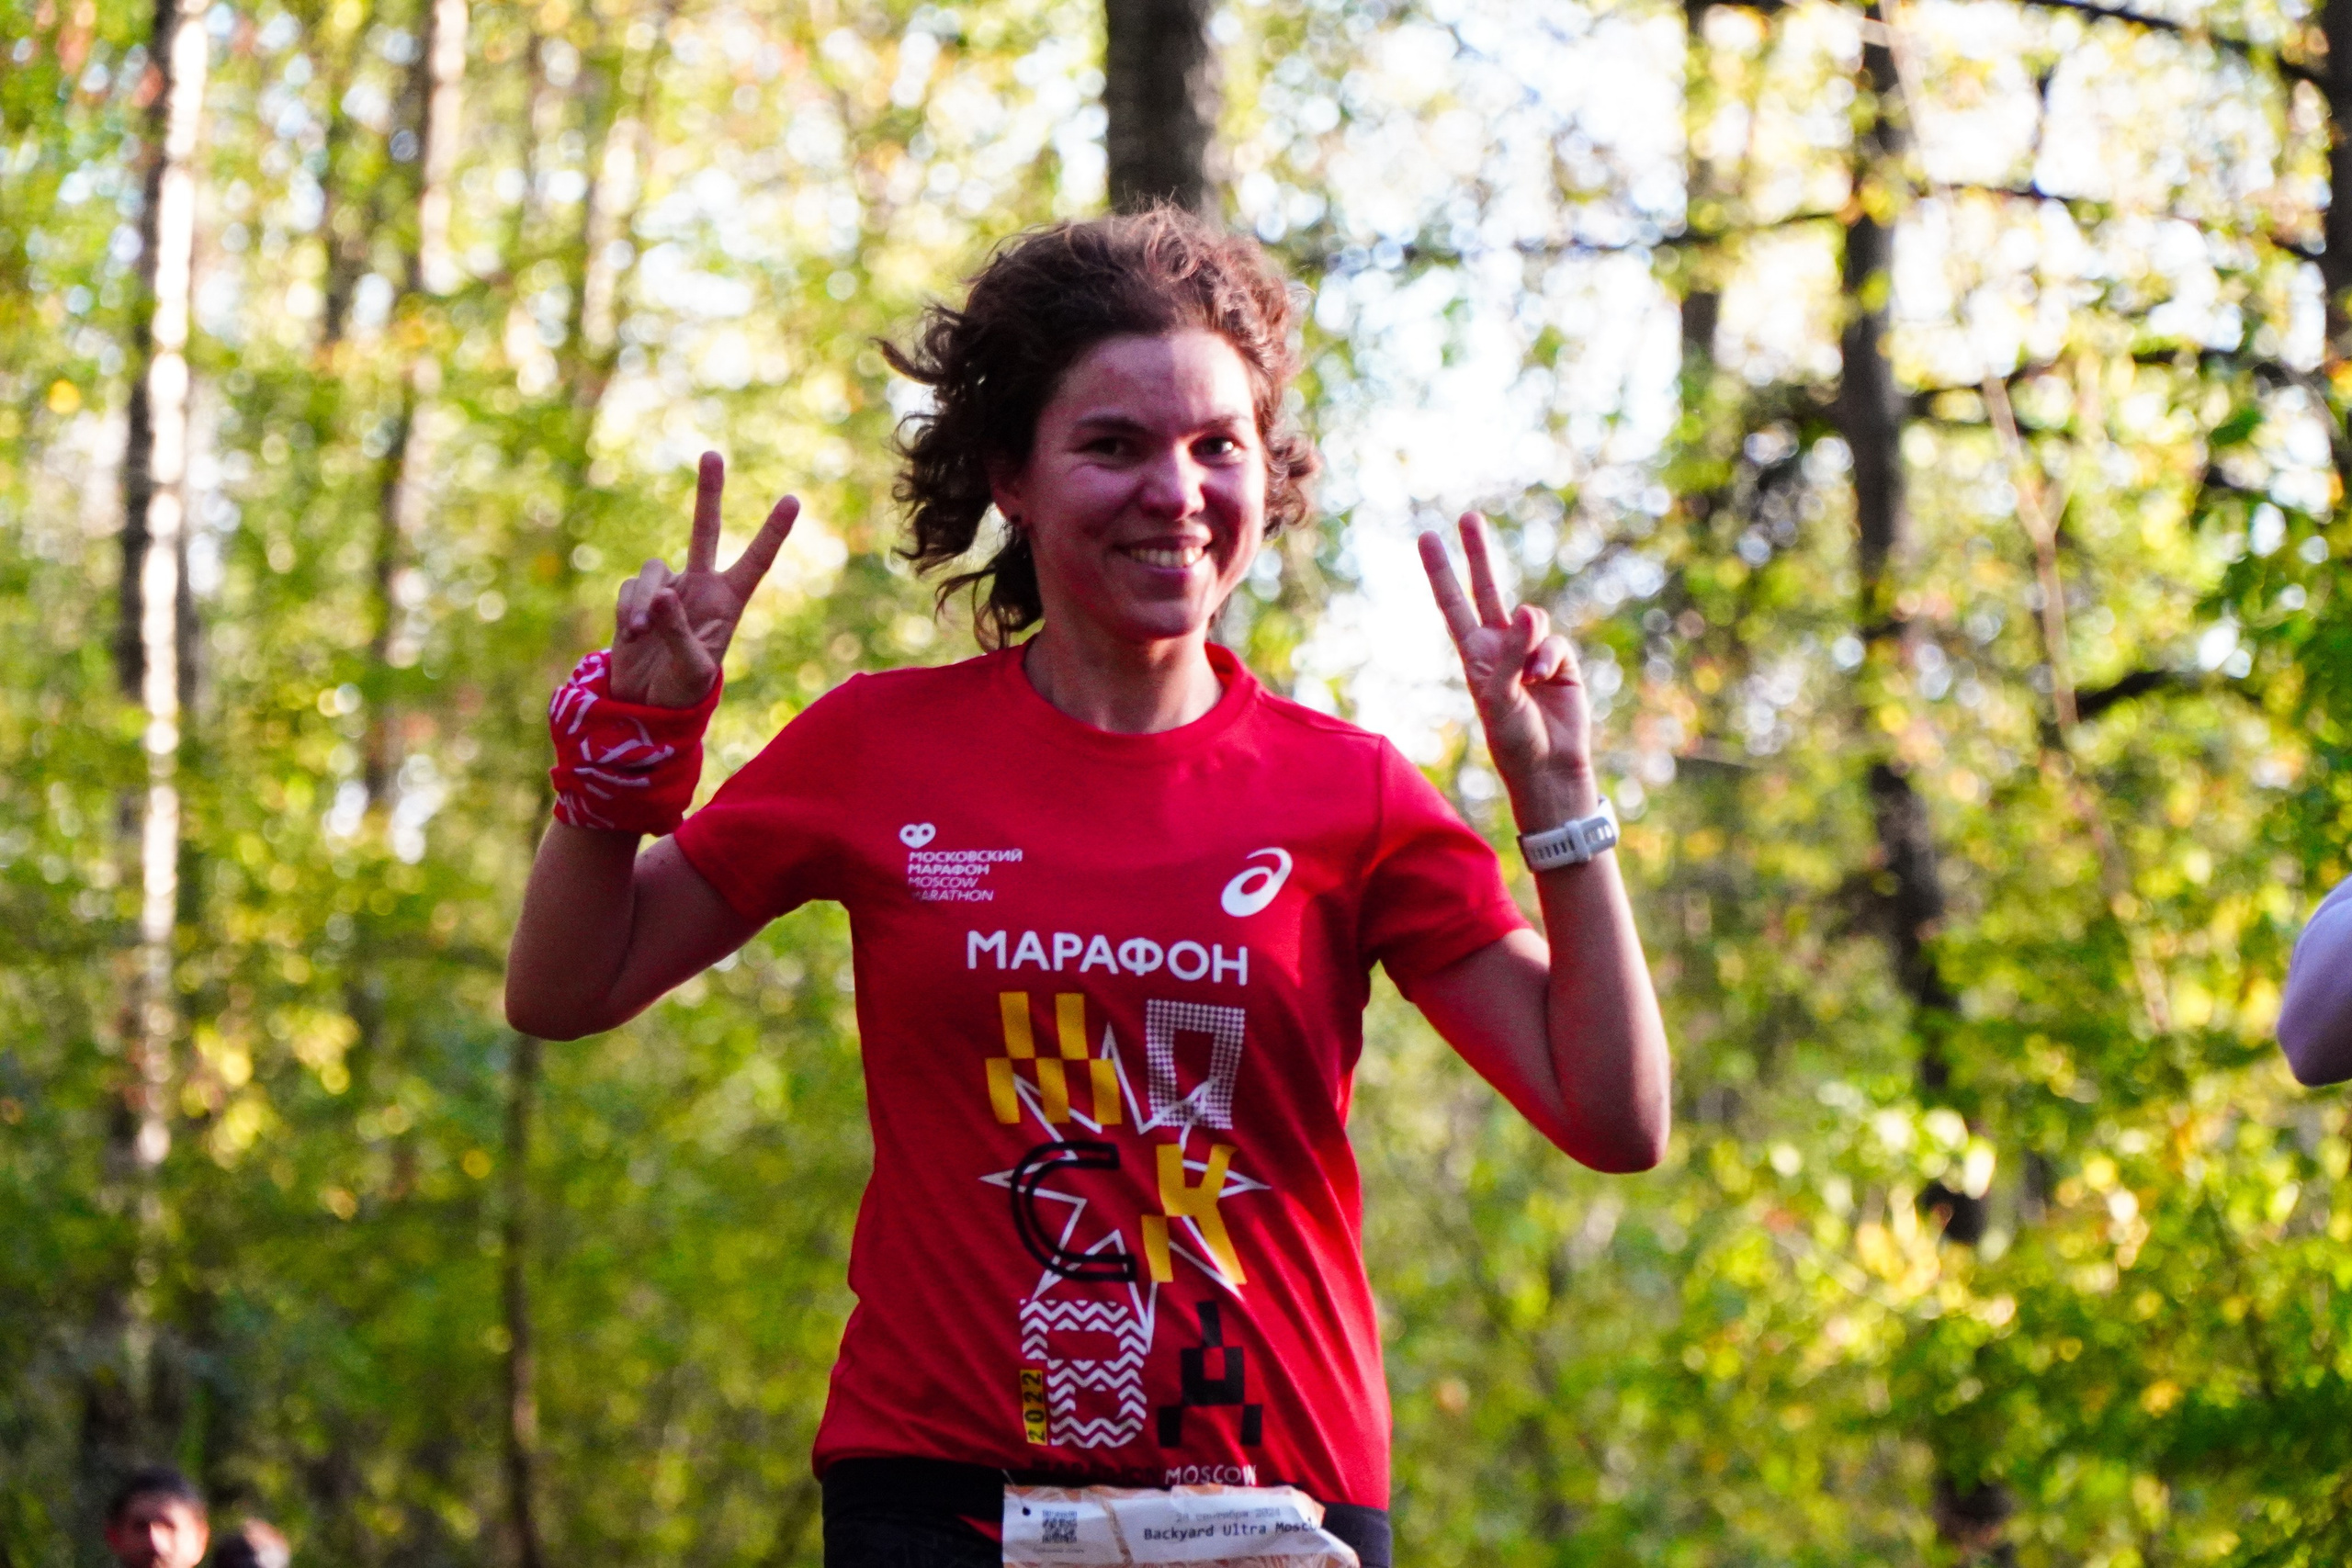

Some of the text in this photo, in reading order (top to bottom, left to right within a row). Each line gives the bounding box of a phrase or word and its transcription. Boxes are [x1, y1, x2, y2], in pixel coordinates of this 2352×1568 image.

[909, 849, 1023, 863] МОСКОВСКИЙ
[908, 863, 989, 875] МАРАФОН
[908, 876, 978, 888] MOSCOW
[967, 930, 1248, 986] МАРАФОН
[1021, 1371, 1046, 1444] 2022
[1164, 1464, 1257, 1486] MOSCOW
[1144, 1525, 1215, 1541] Backyard
[1223, 1522, 1267, 1537] Ultra
